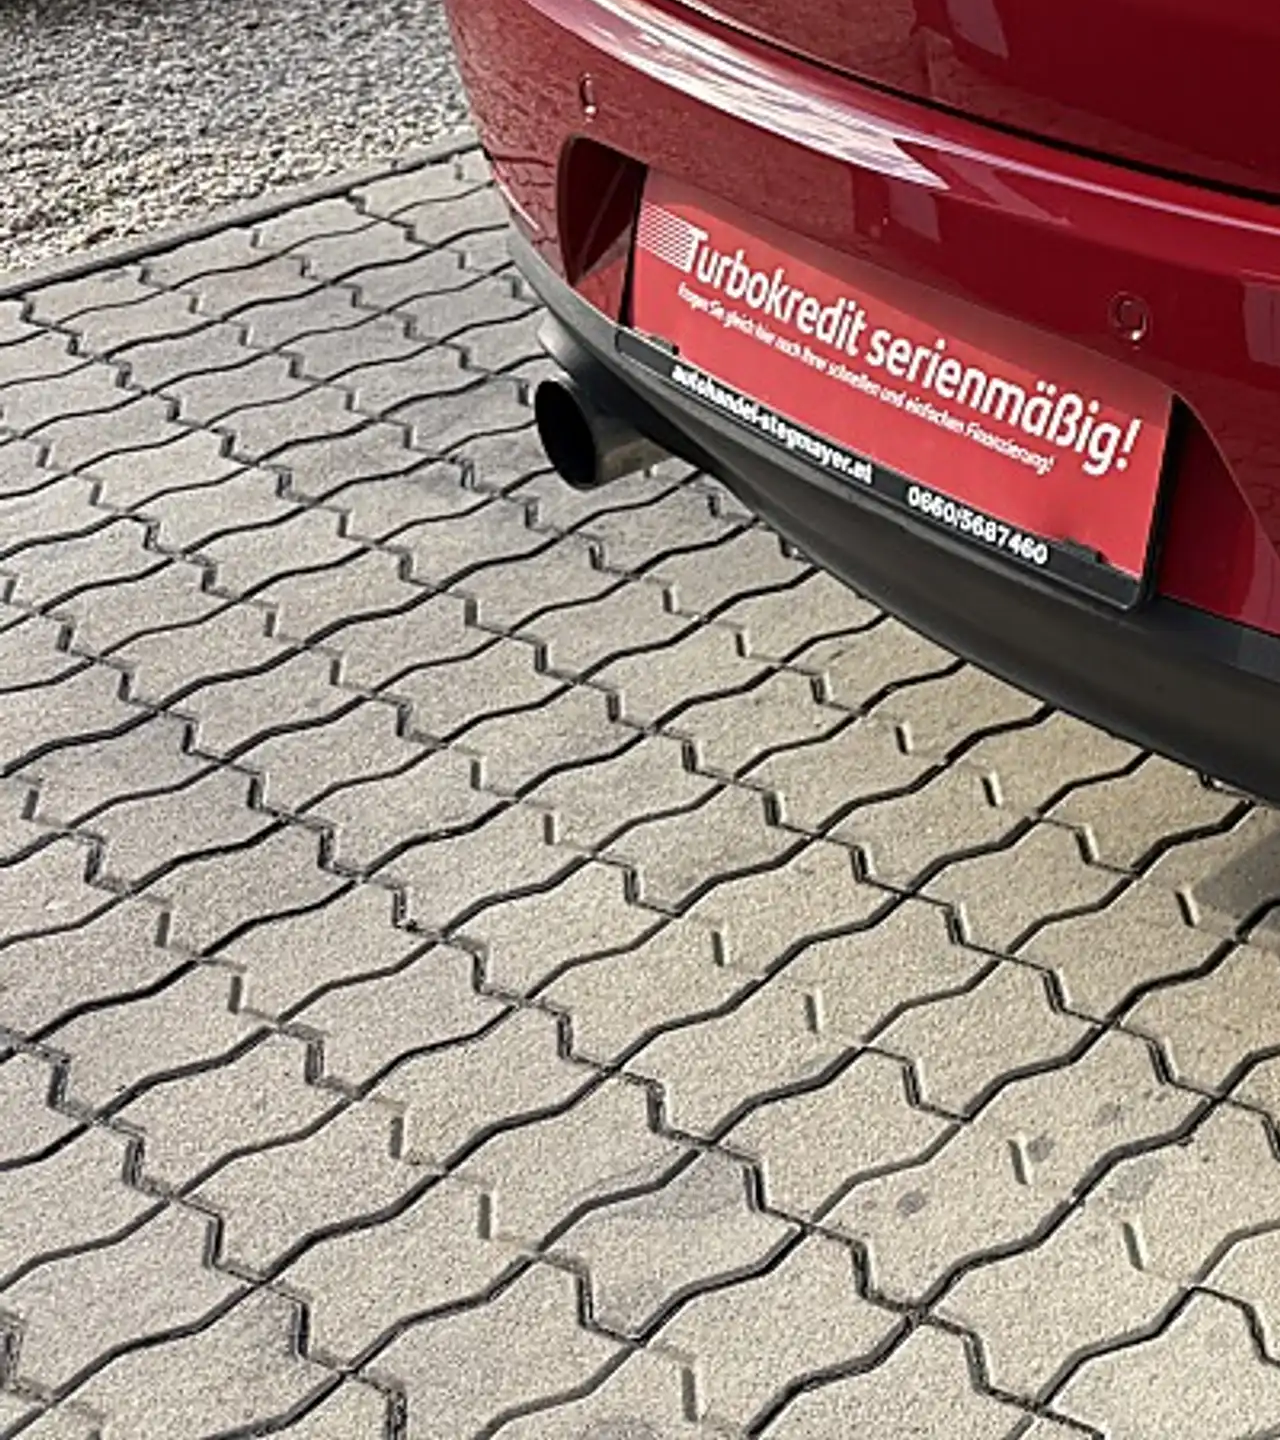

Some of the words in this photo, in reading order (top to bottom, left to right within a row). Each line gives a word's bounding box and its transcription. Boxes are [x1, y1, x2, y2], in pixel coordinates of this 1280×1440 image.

[685, 227, 868, 357] Turbokredit
[864, 328, 1143, 476] serienmäßig!
[708, 299, 725, 321] Sie
[827, 362, 881, 397] schnellen
[879, 387, 906, 409] und
[904, 396, 965, 435] einfachen
[964, 420, 1056, 476] Finanzierung!
[907, 485, 1048, 565] 0660/5687460
